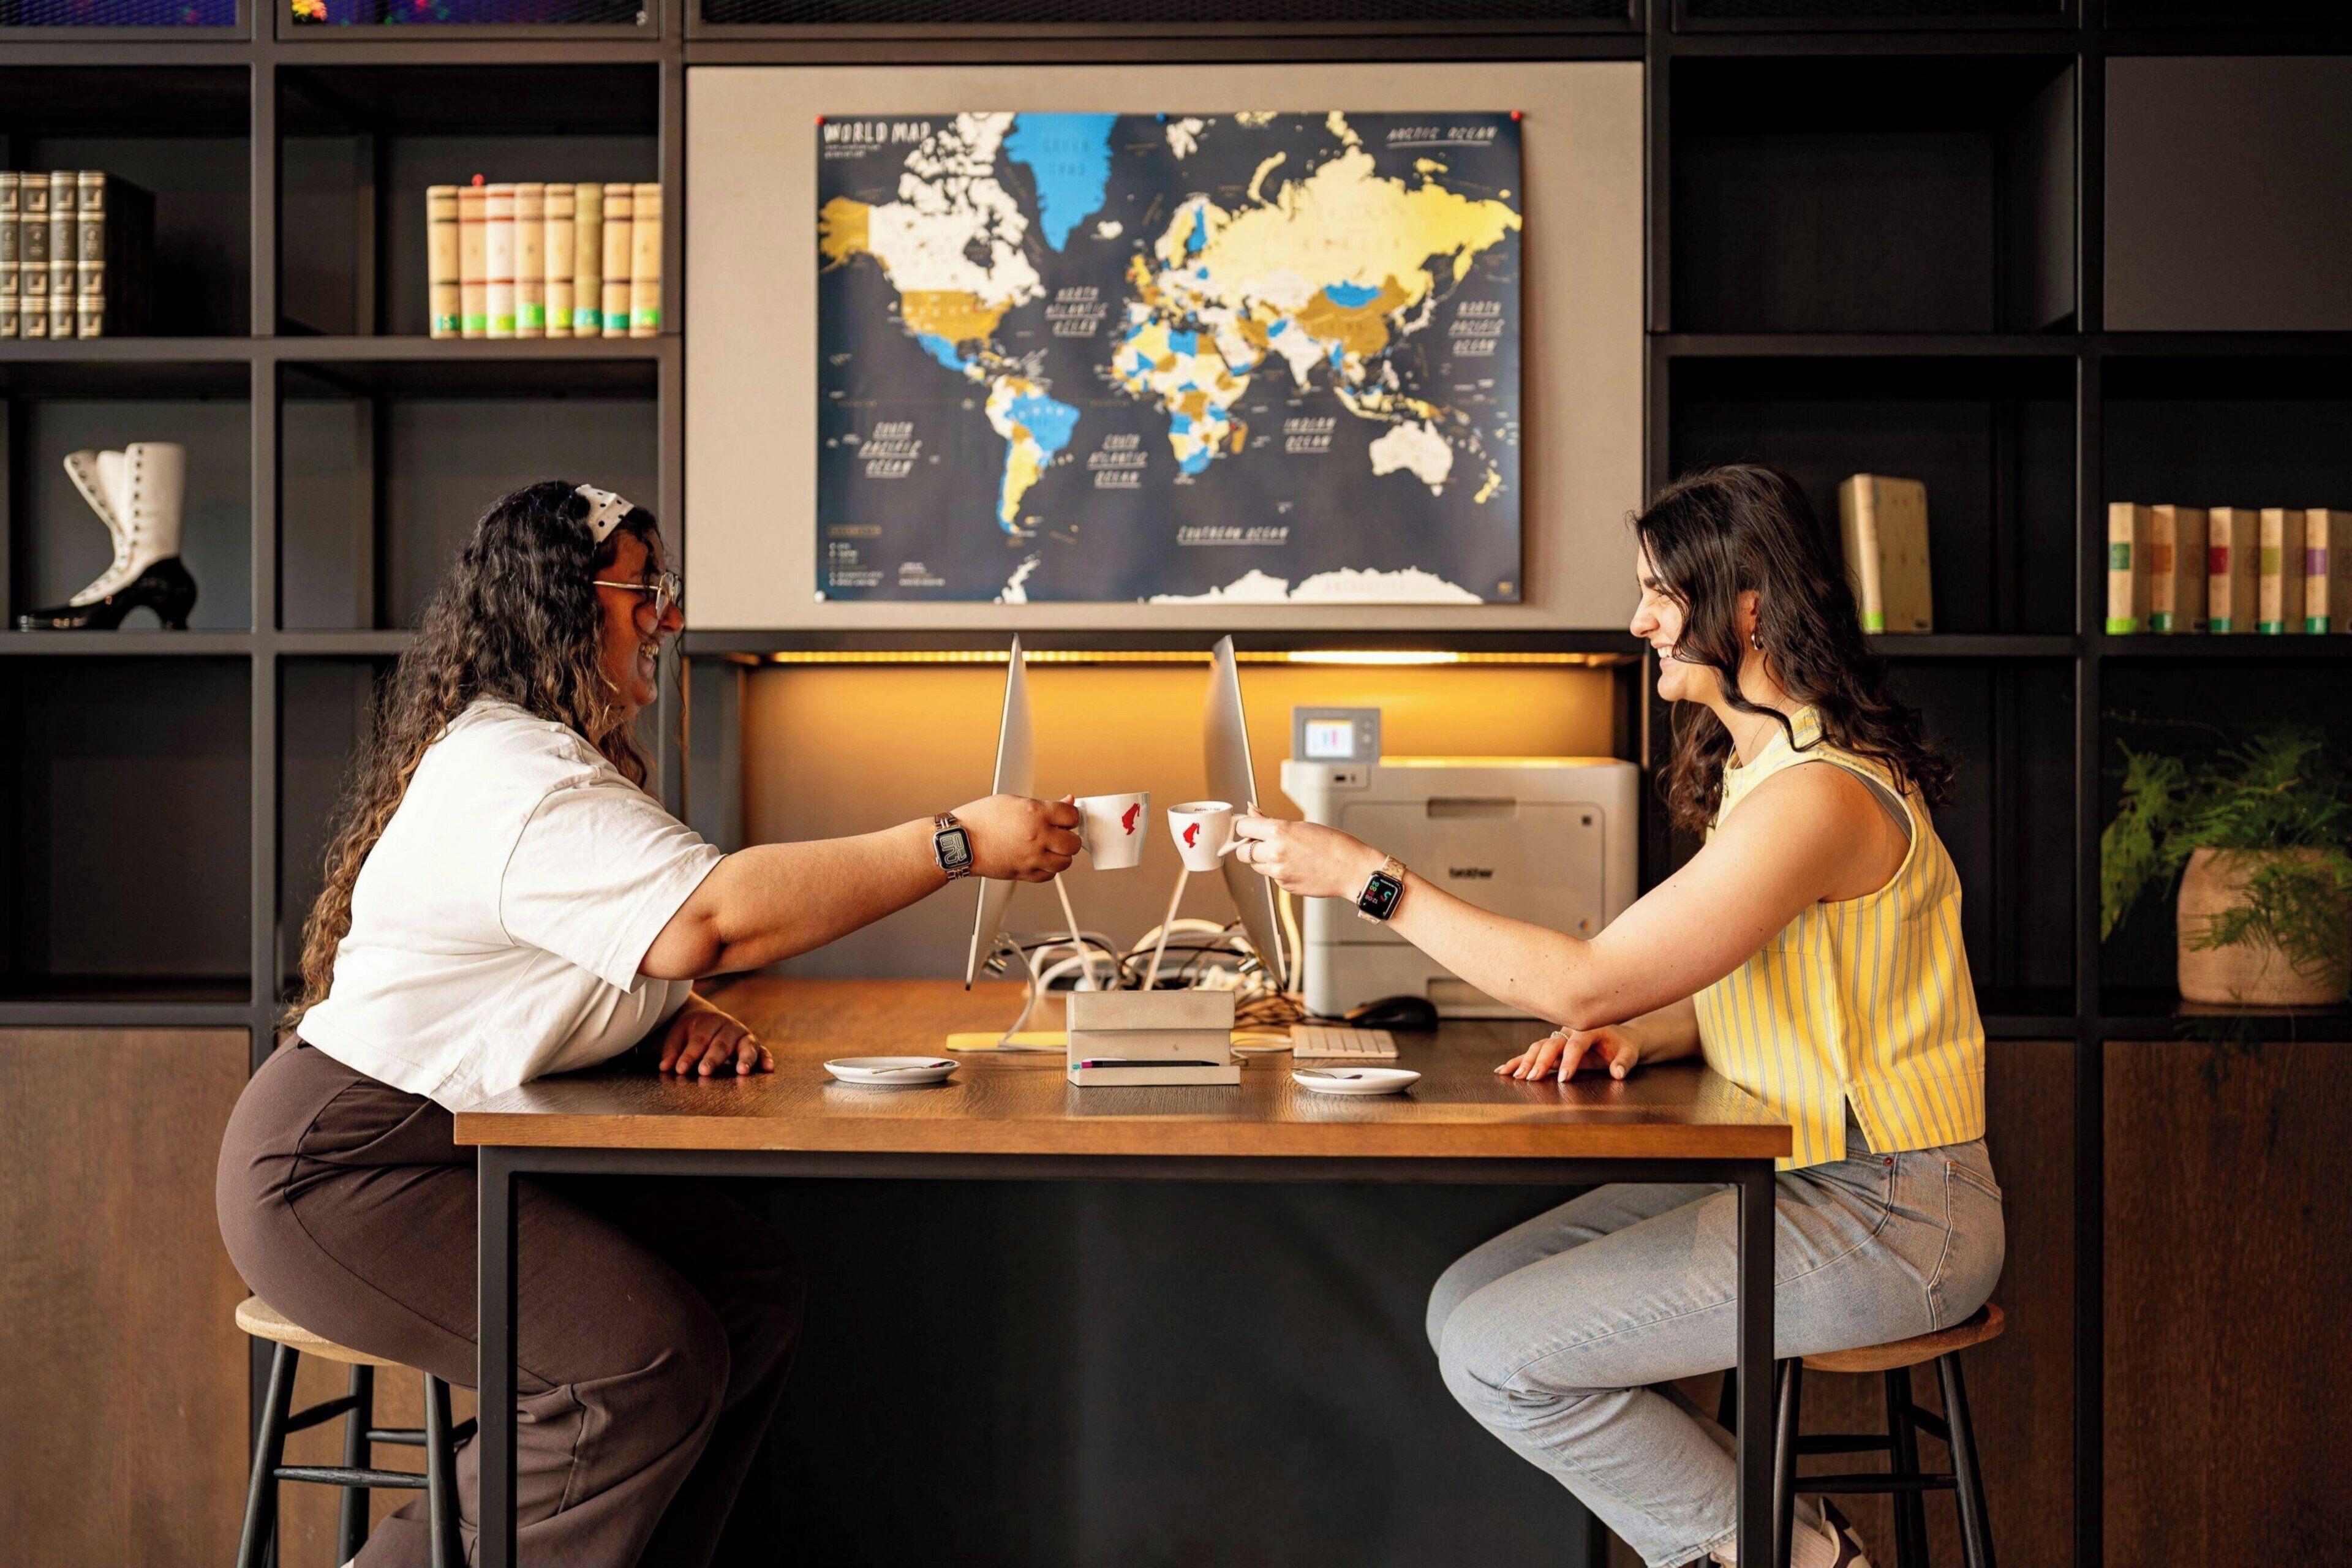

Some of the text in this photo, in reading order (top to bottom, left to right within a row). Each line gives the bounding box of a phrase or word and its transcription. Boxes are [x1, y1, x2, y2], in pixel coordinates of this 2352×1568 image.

[824, 121, 930, 144] WORLD MAP
[1447, 126, 1498, 141] OCEAN
[1053, 320, 1098, 334] OCEAN
[1452, 339, 1497, 353] OCEAN
[1285, 435, 1332, 450] OCEAN
[865, 460, 913, 474] OCEAN
[1095, 471, 1139, 485] OCEAN
[1246, 526, 1289, 540] OCEAN
[943, 846, 967, 864] 12
[1365, 894, 1378, 904] 12:08
